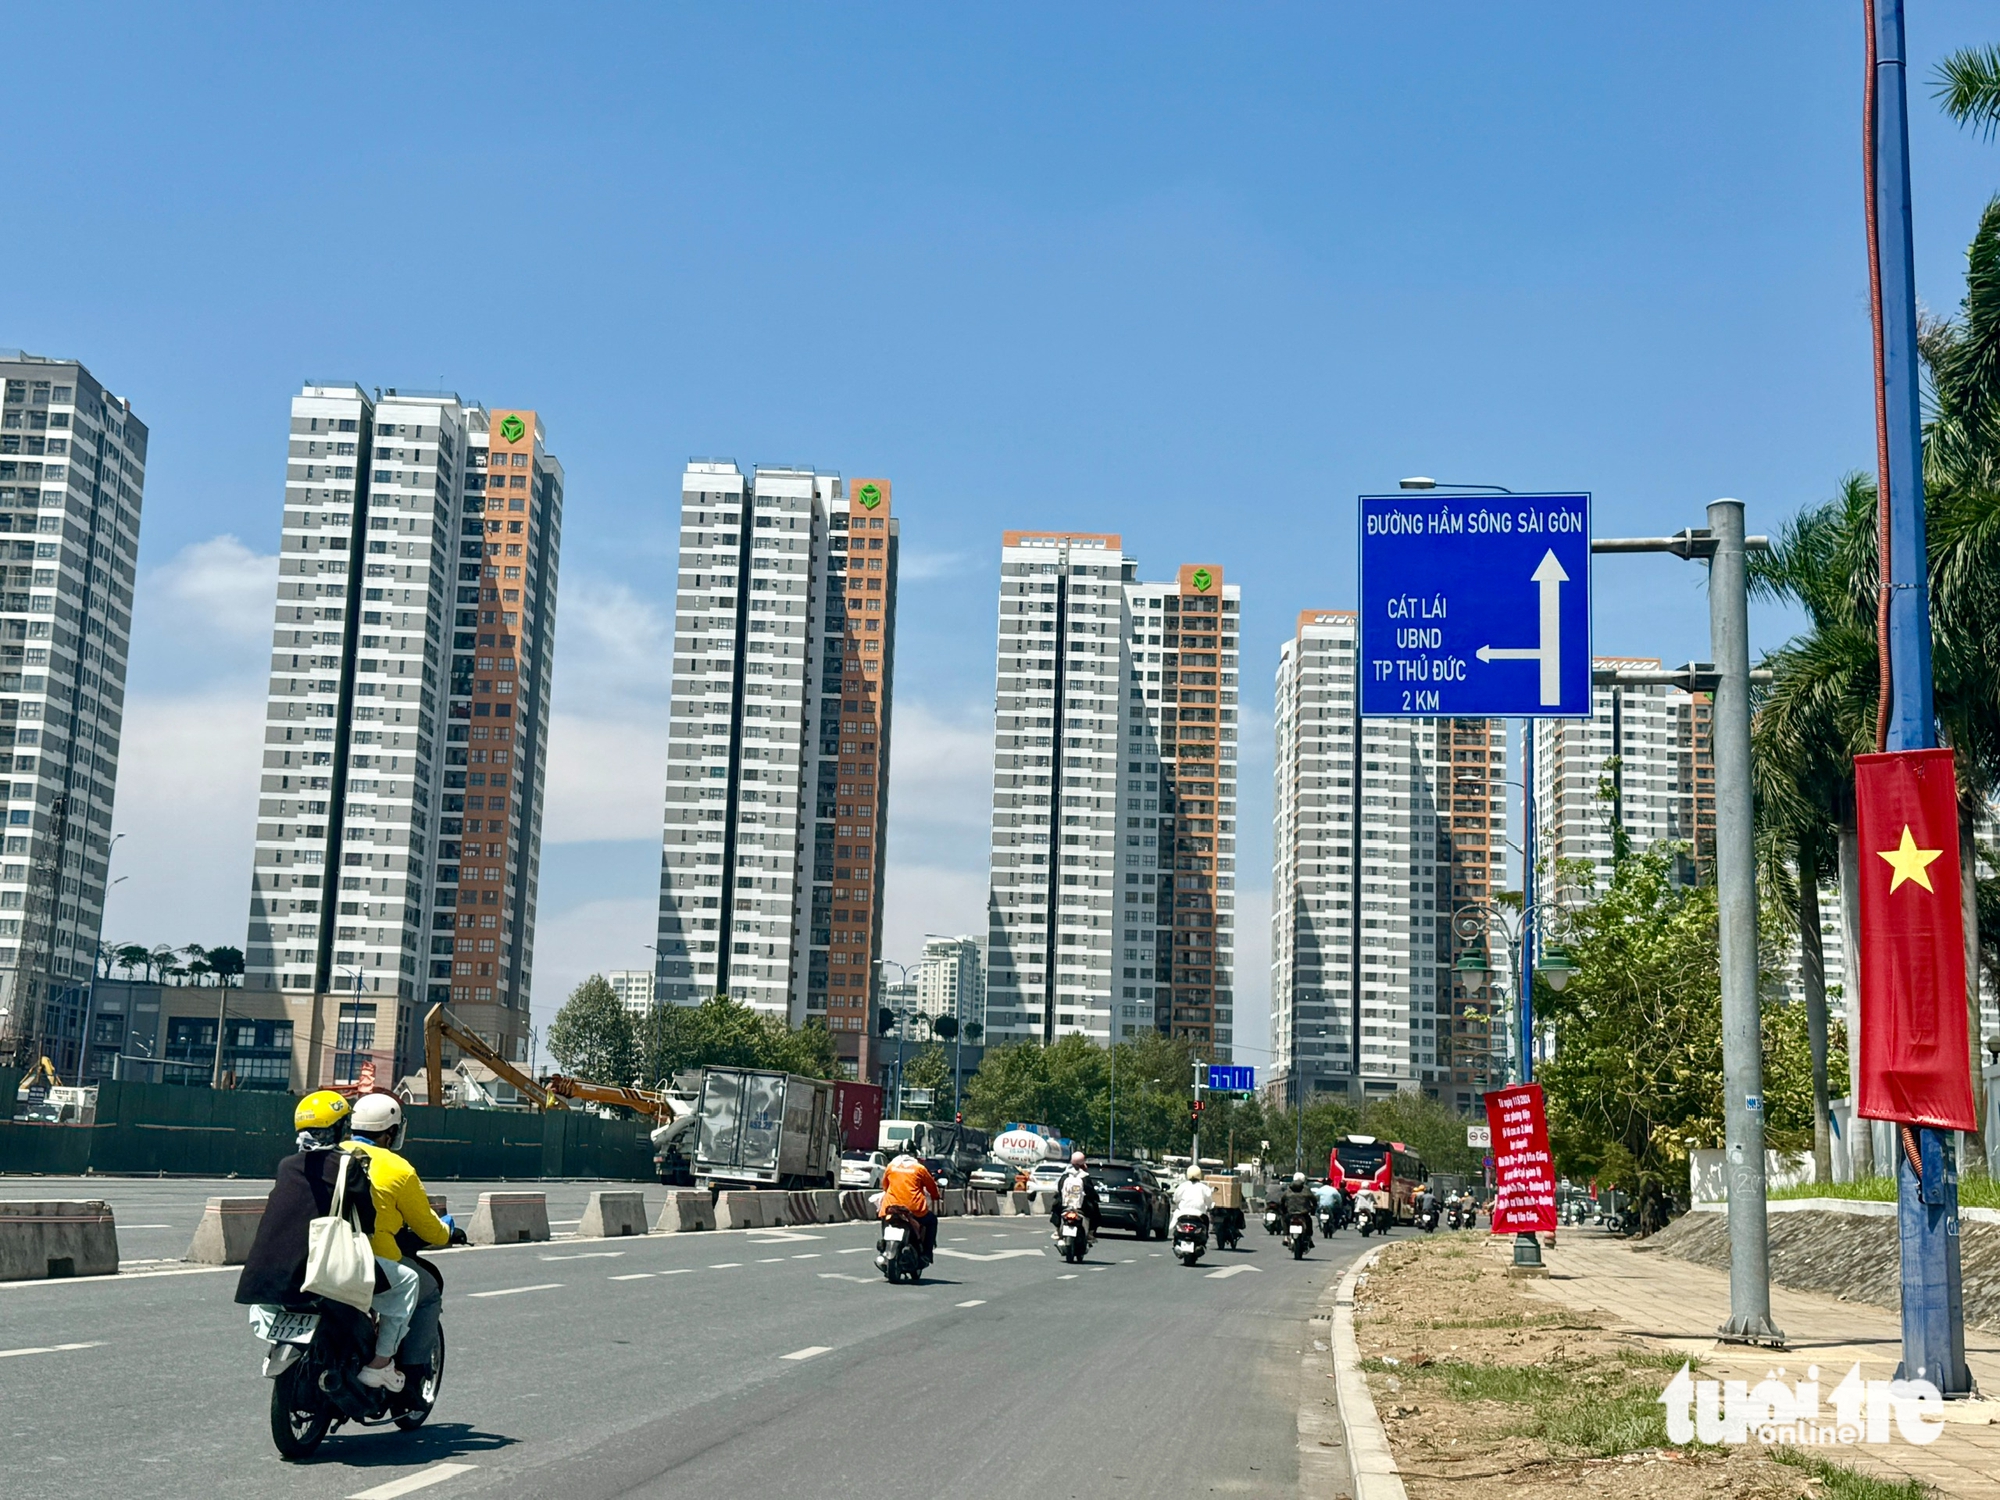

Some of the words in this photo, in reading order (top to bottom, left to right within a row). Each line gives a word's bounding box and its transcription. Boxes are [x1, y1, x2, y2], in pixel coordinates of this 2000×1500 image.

[1367, 509, 1423, 535] ĐƯỜNG
[1428, 505, 1463, 534] HẦM
[1468, 509, 1512, 533] SÔNG
[1517, 507, 1543, 533] SÀI
[1548, 507, 1582, 533] GÒN
[1388, 593, 1417, 618] CÁT
[1421, 593, 1446, 618] LÁI
[1396, 628, 1442, 649] UBND
[1373, 660, 1392, 681] TP
[1396, 654, 1428, 681] THỦ
[1433, 655, 1466, 681] ĐỨC
[1402, 691, 1411, 711] 2
[1416, 690, 1439, 710] KM
